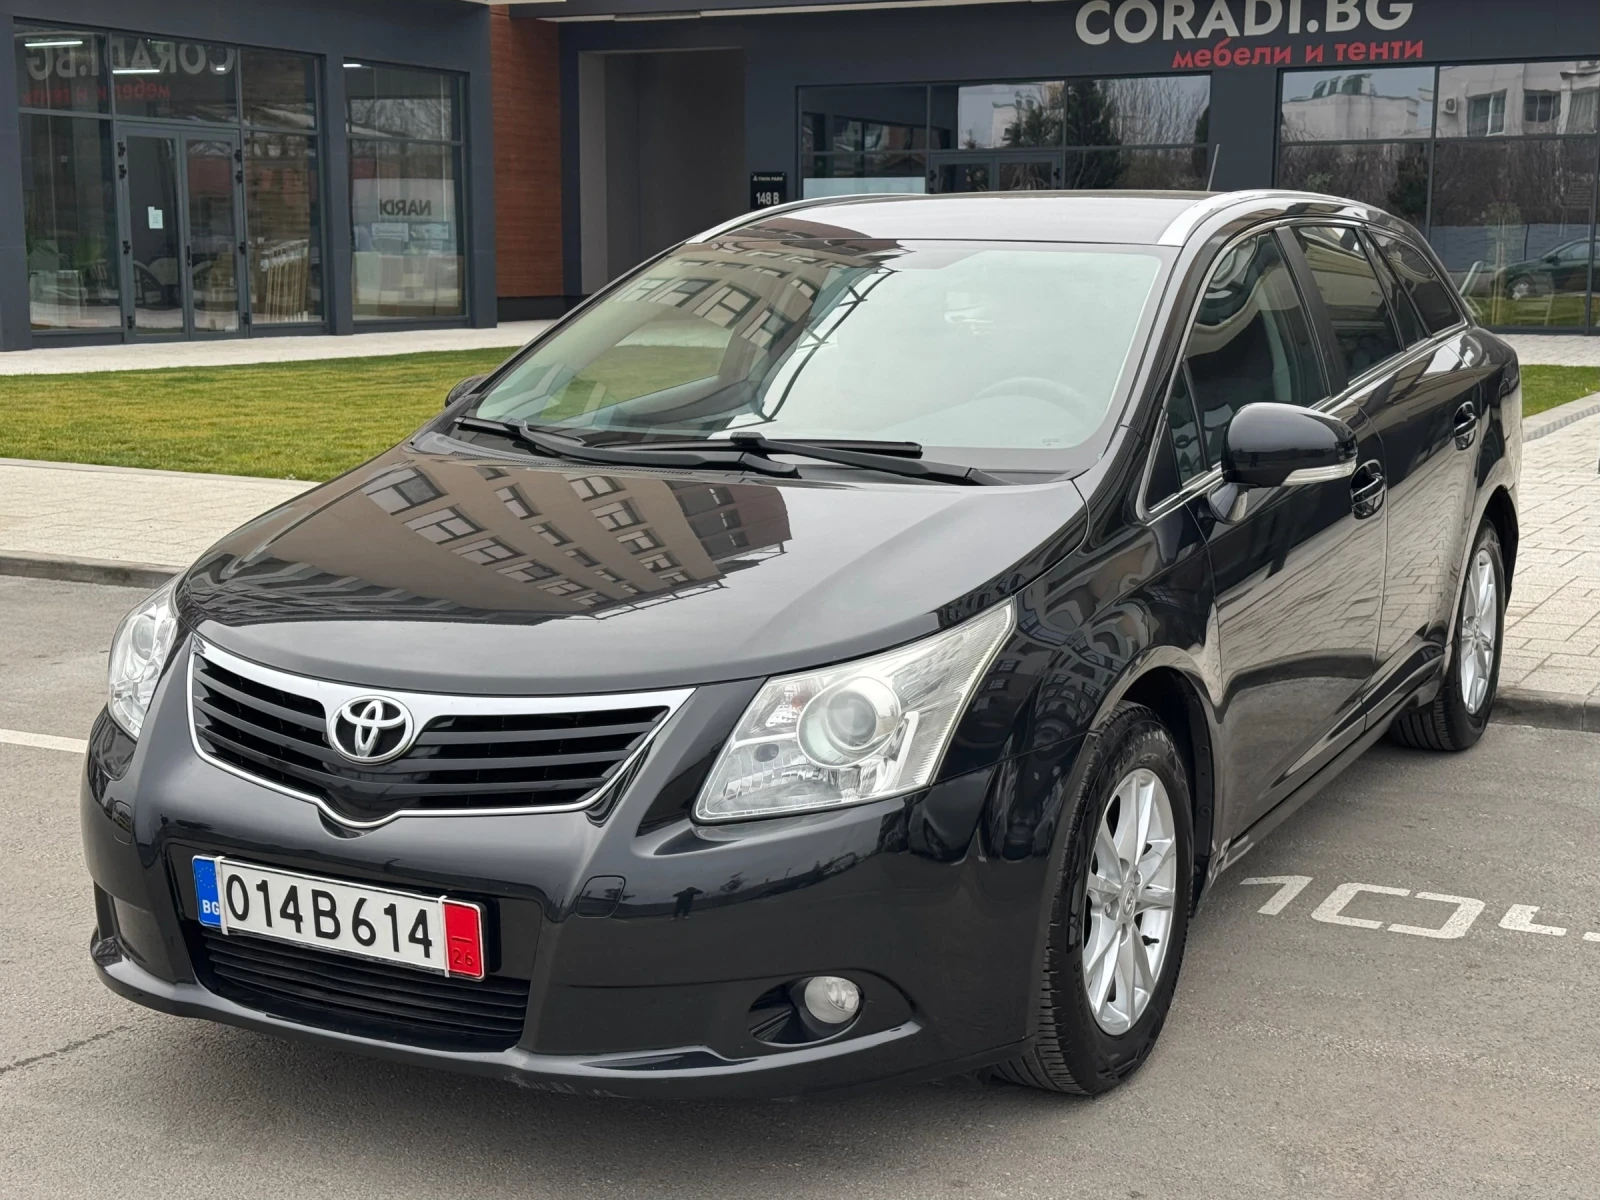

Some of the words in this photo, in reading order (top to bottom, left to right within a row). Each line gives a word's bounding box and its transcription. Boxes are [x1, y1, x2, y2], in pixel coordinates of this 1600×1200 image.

[1075, 0, 1414, 45] CORADI.BG
[1172, 38, 1291, 68] мебели
[1305, 44, 1324, 63] и
[1335, 40, 1423, 61] тенти
[756, 192, 772, 205] 148
[773, 192, 779, 205] B
[202, 899, 220, 916] BG
[225, 873, 433, 959] 014B614
[453, 947, 474, 967] 26
